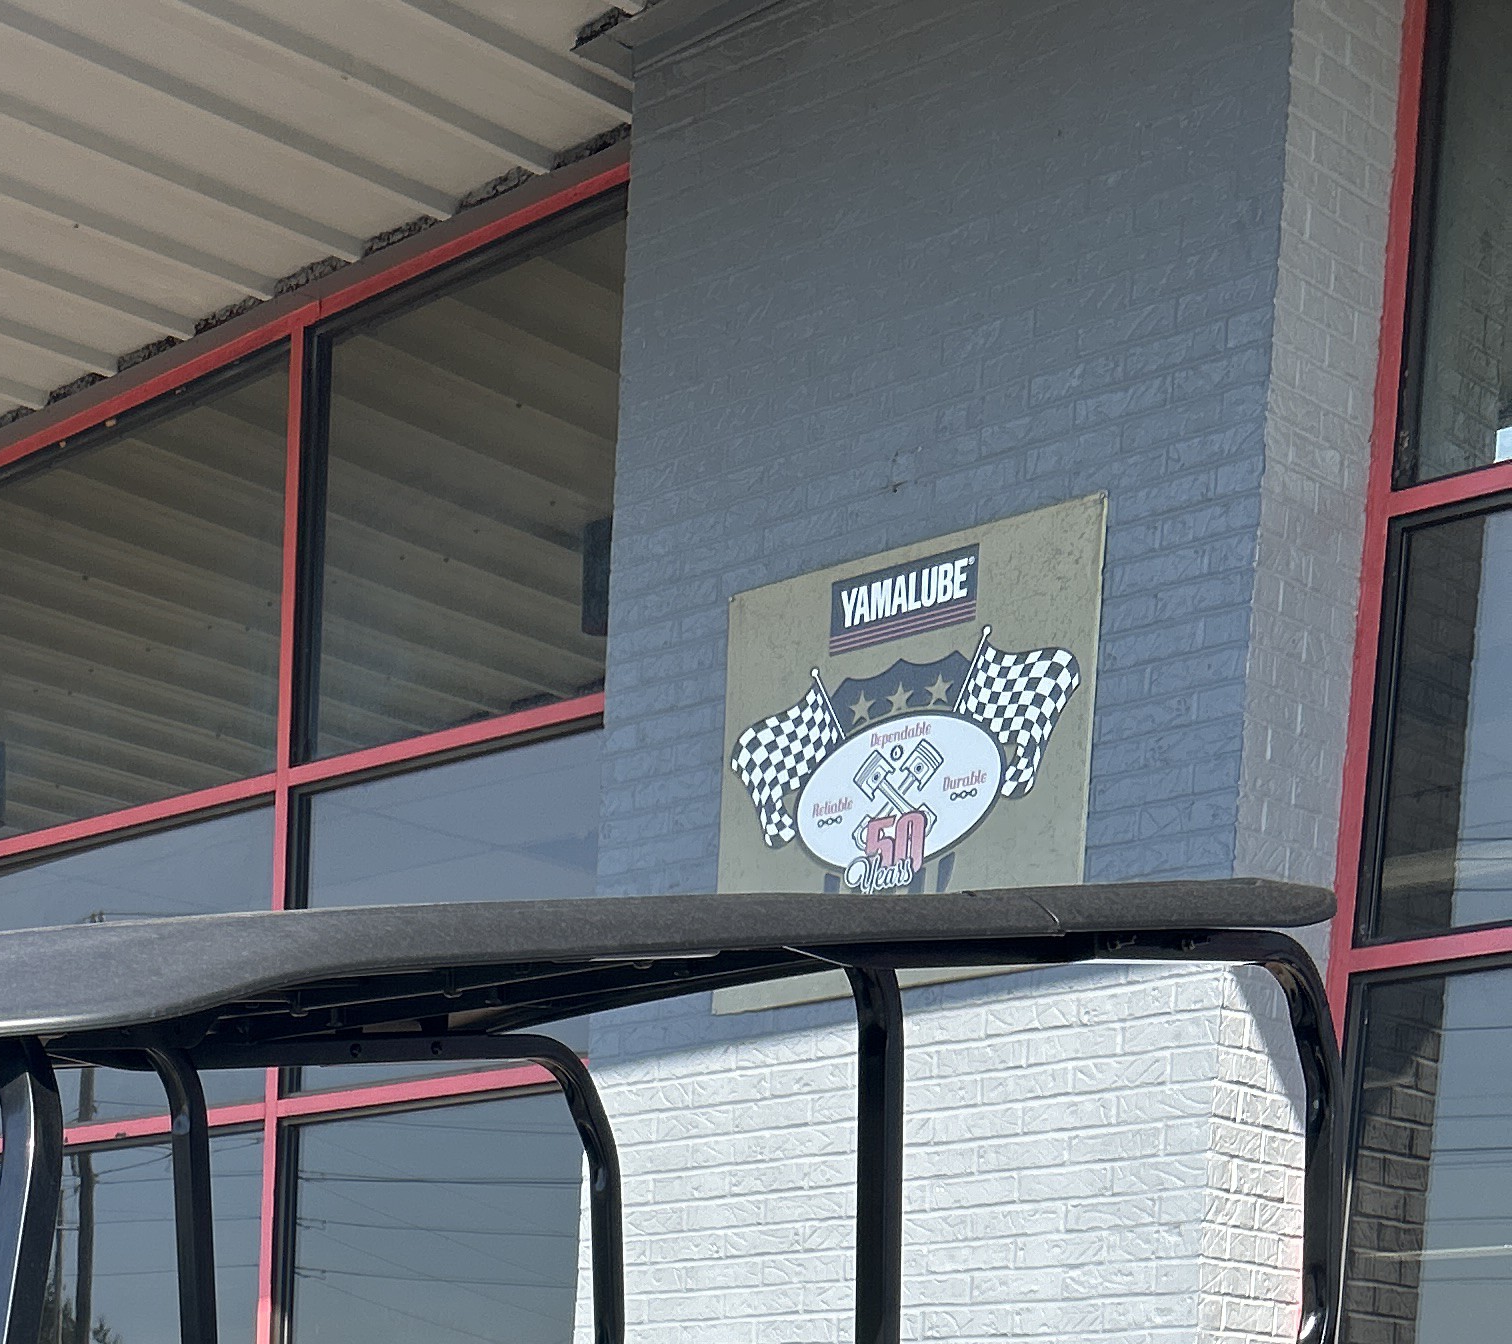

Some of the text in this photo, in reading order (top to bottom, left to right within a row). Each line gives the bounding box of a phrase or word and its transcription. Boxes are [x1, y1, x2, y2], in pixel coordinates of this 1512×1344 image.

[870, 721, 932, 749] Dependable
[943, 769, 988, 792] Durable
[812, 796, 854, 819] Reliable
[864, 809, 927, 874] 50
[844, 852, 913, 895] Years
